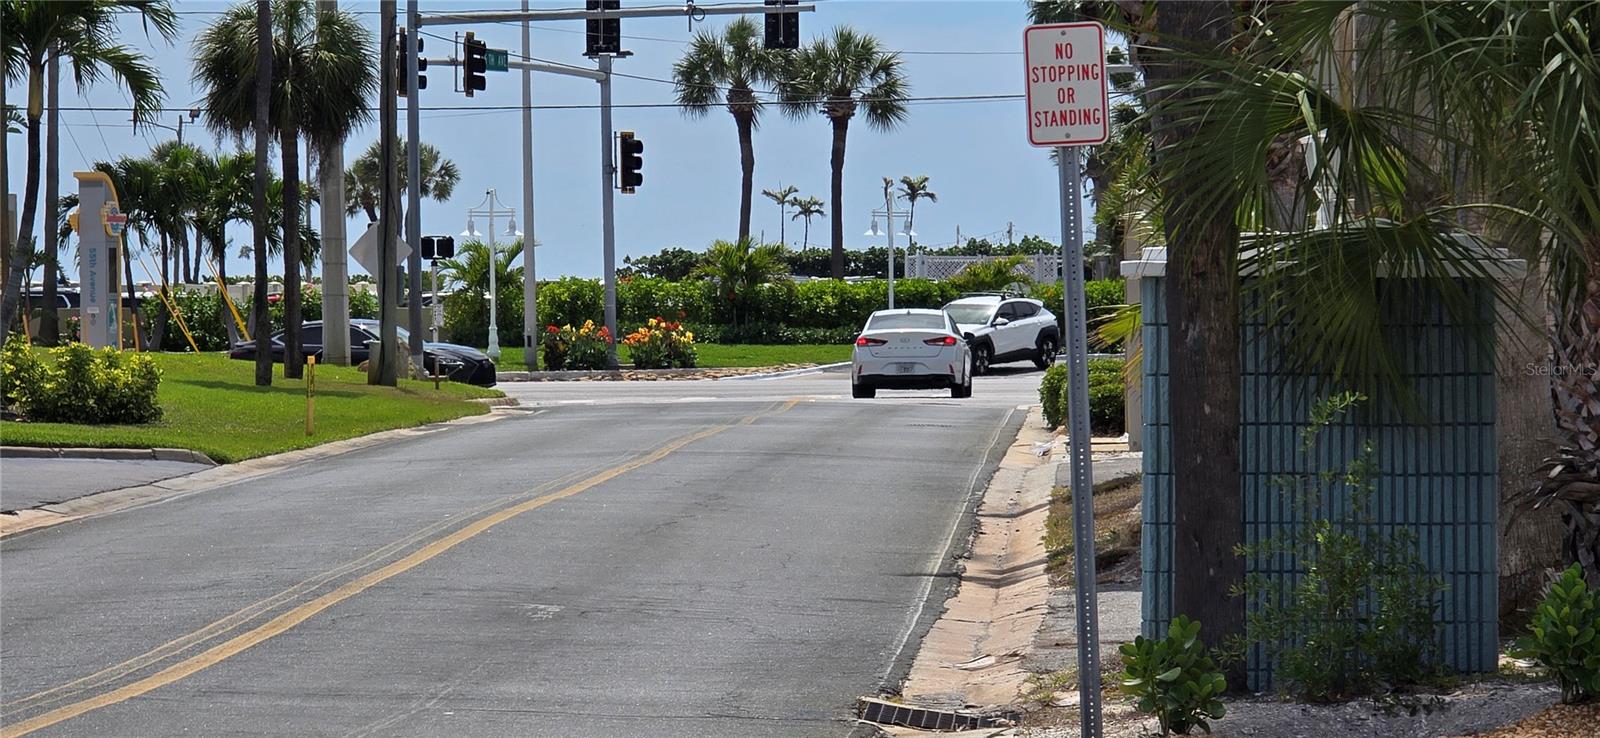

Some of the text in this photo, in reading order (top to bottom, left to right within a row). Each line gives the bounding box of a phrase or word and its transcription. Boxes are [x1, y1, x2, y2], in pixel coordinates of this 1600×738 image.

[1055, 43, 1073, 60] NO
[1032, 64, 1099, 83] STOPPING
[1057, 87, 1075, 104] OR
[1034, 108, 1101, 127] STANDING
[89, 248, 97, 304] 55th Avenue
